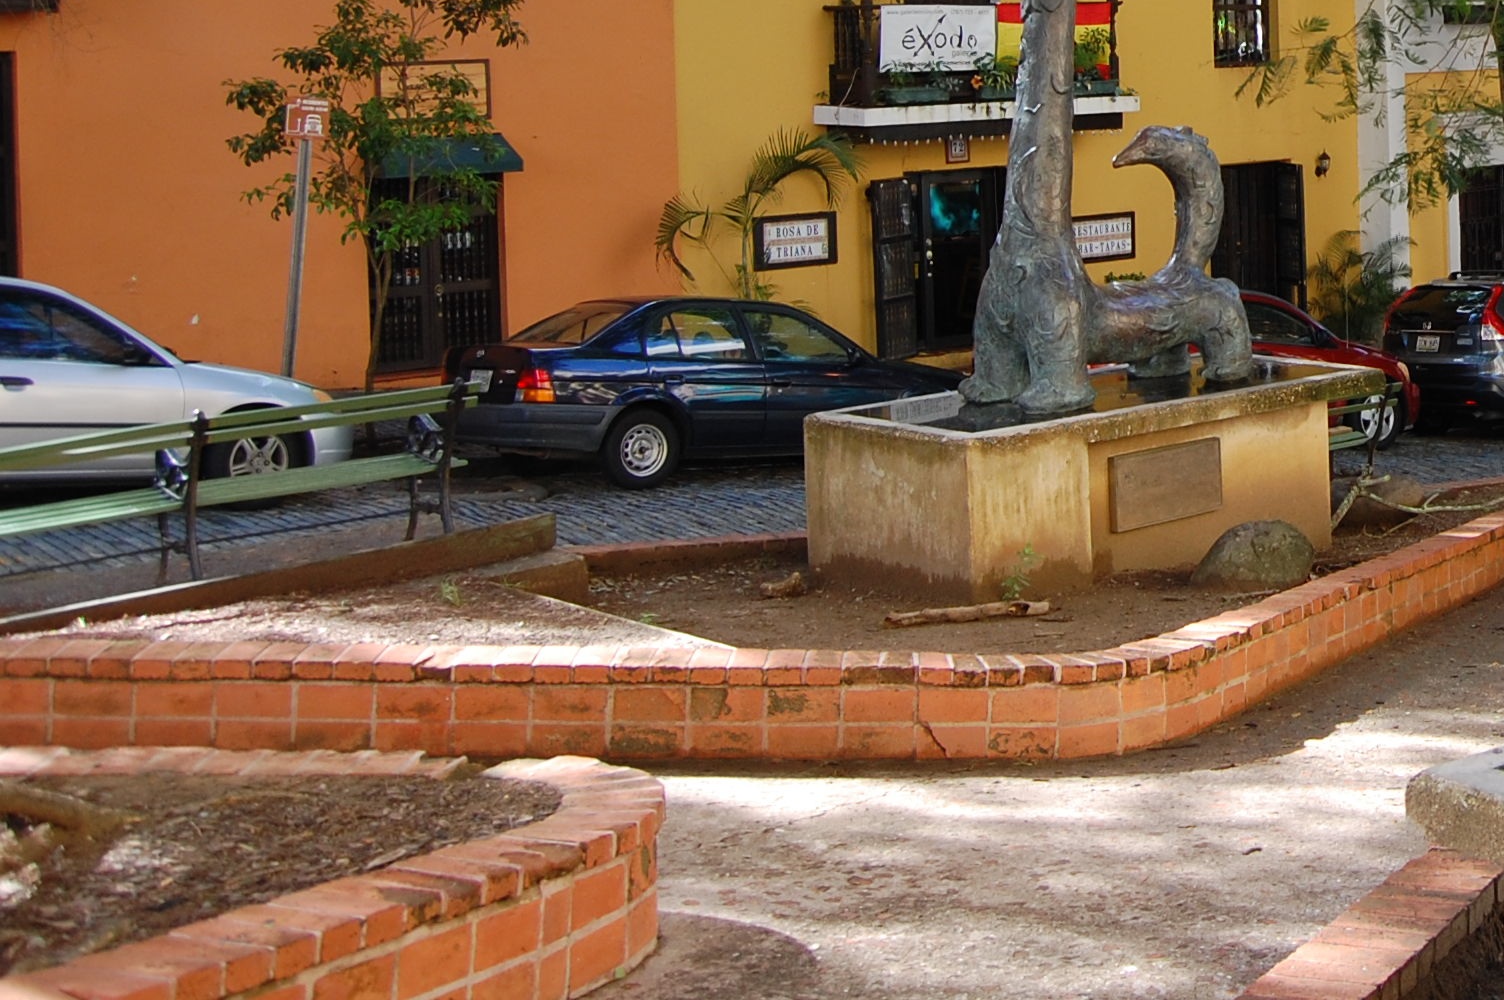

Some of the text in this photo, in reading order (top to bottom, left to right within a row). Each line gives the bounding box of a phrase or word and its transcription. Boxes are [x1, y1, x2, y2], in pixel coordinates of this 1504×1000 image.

[776, 224, 819, 238] ROSA DE
[776, 245, 813, 258] TRIANA
